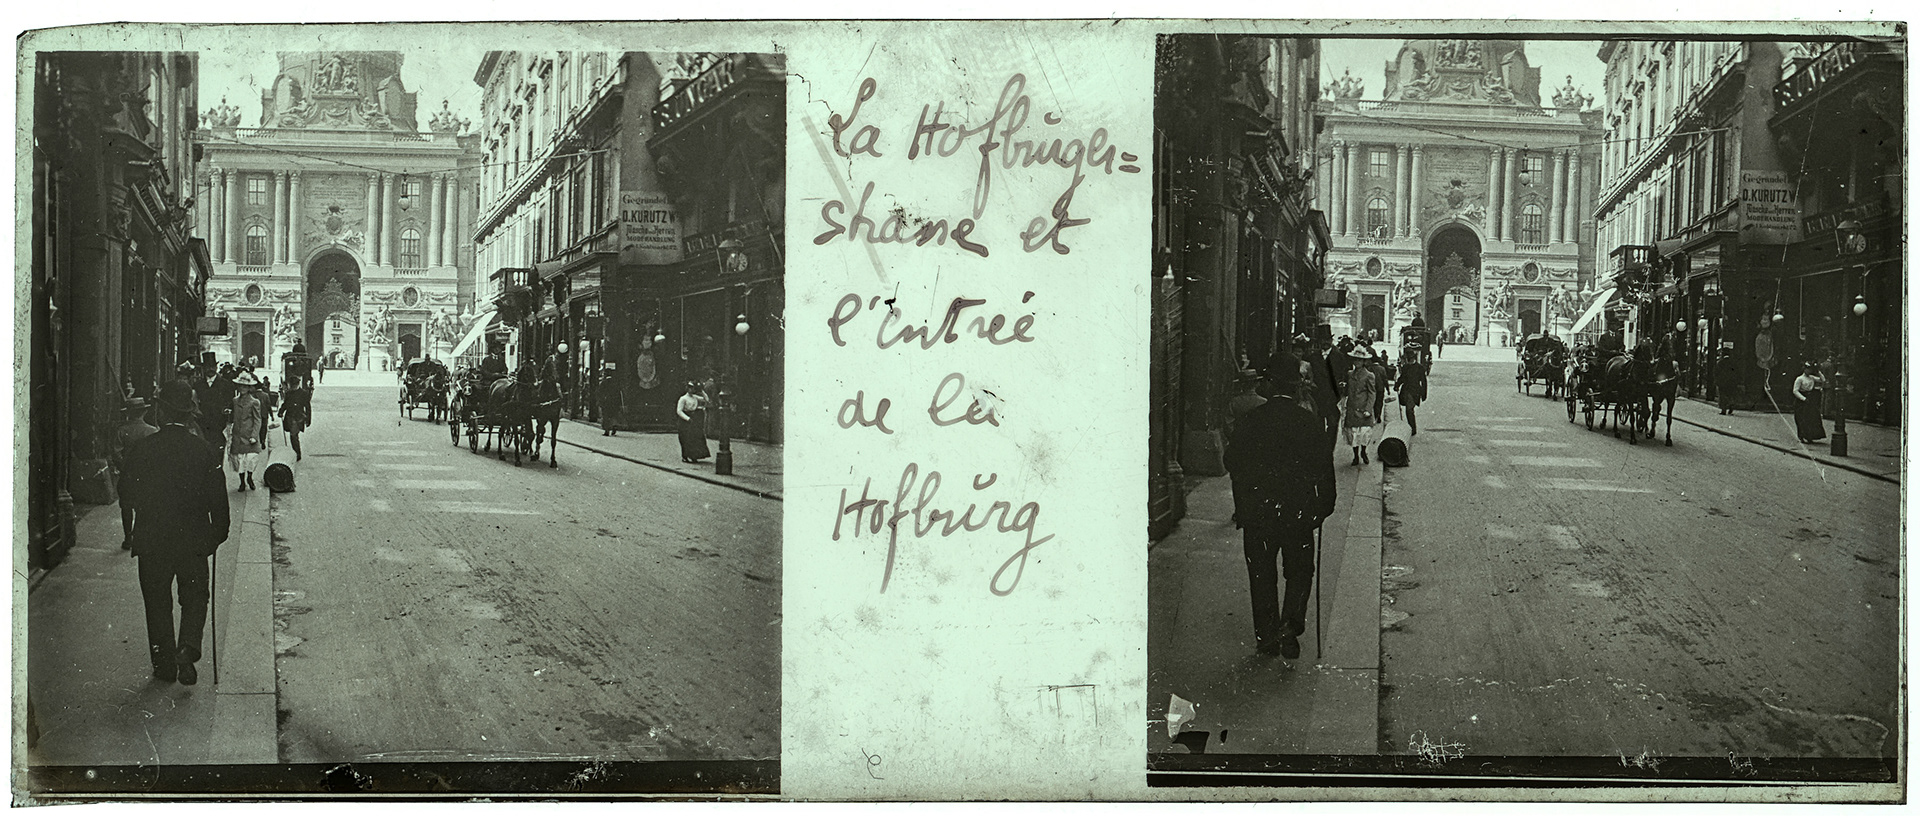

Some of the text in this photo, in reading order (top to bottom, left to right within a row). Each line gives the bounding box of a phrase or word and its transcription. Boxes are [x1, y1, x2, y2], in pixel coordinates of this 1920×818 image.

[827, 77, 883, 158] La
[1020, 203, 1091, 255] et
[837, 372, 1000, 434] de la
